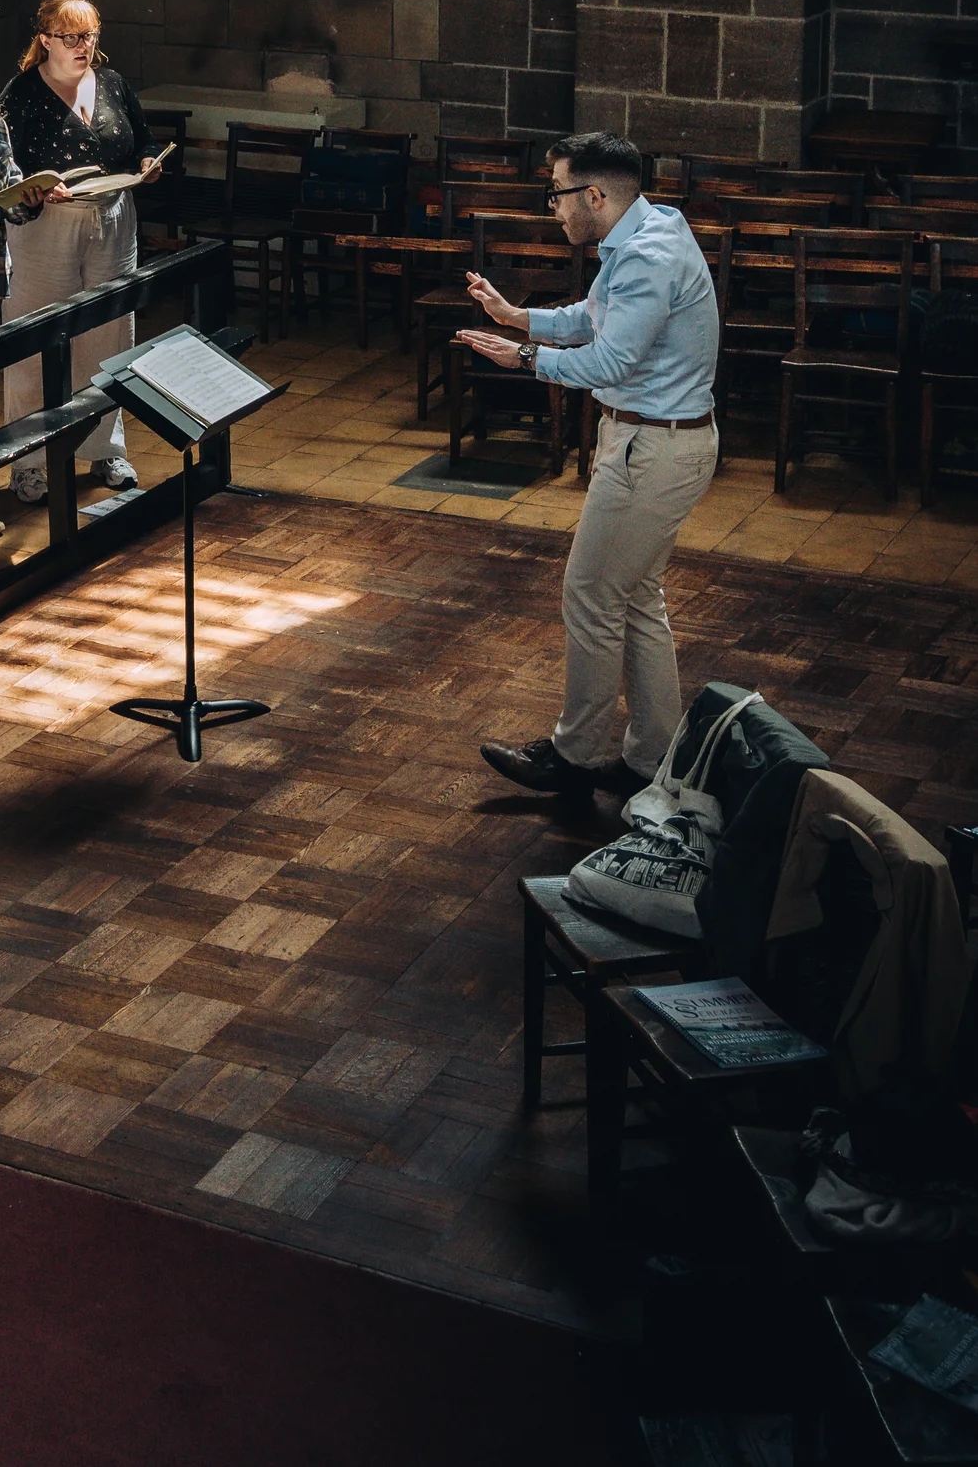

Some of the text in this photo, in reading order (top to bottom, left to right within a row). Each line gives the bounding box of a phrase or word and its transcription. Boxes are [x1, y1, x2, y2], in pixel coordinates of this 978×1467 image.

[659, 994, 758, 1012] A SUMMER
[675, 1005, 753, 1018] SERENADE
